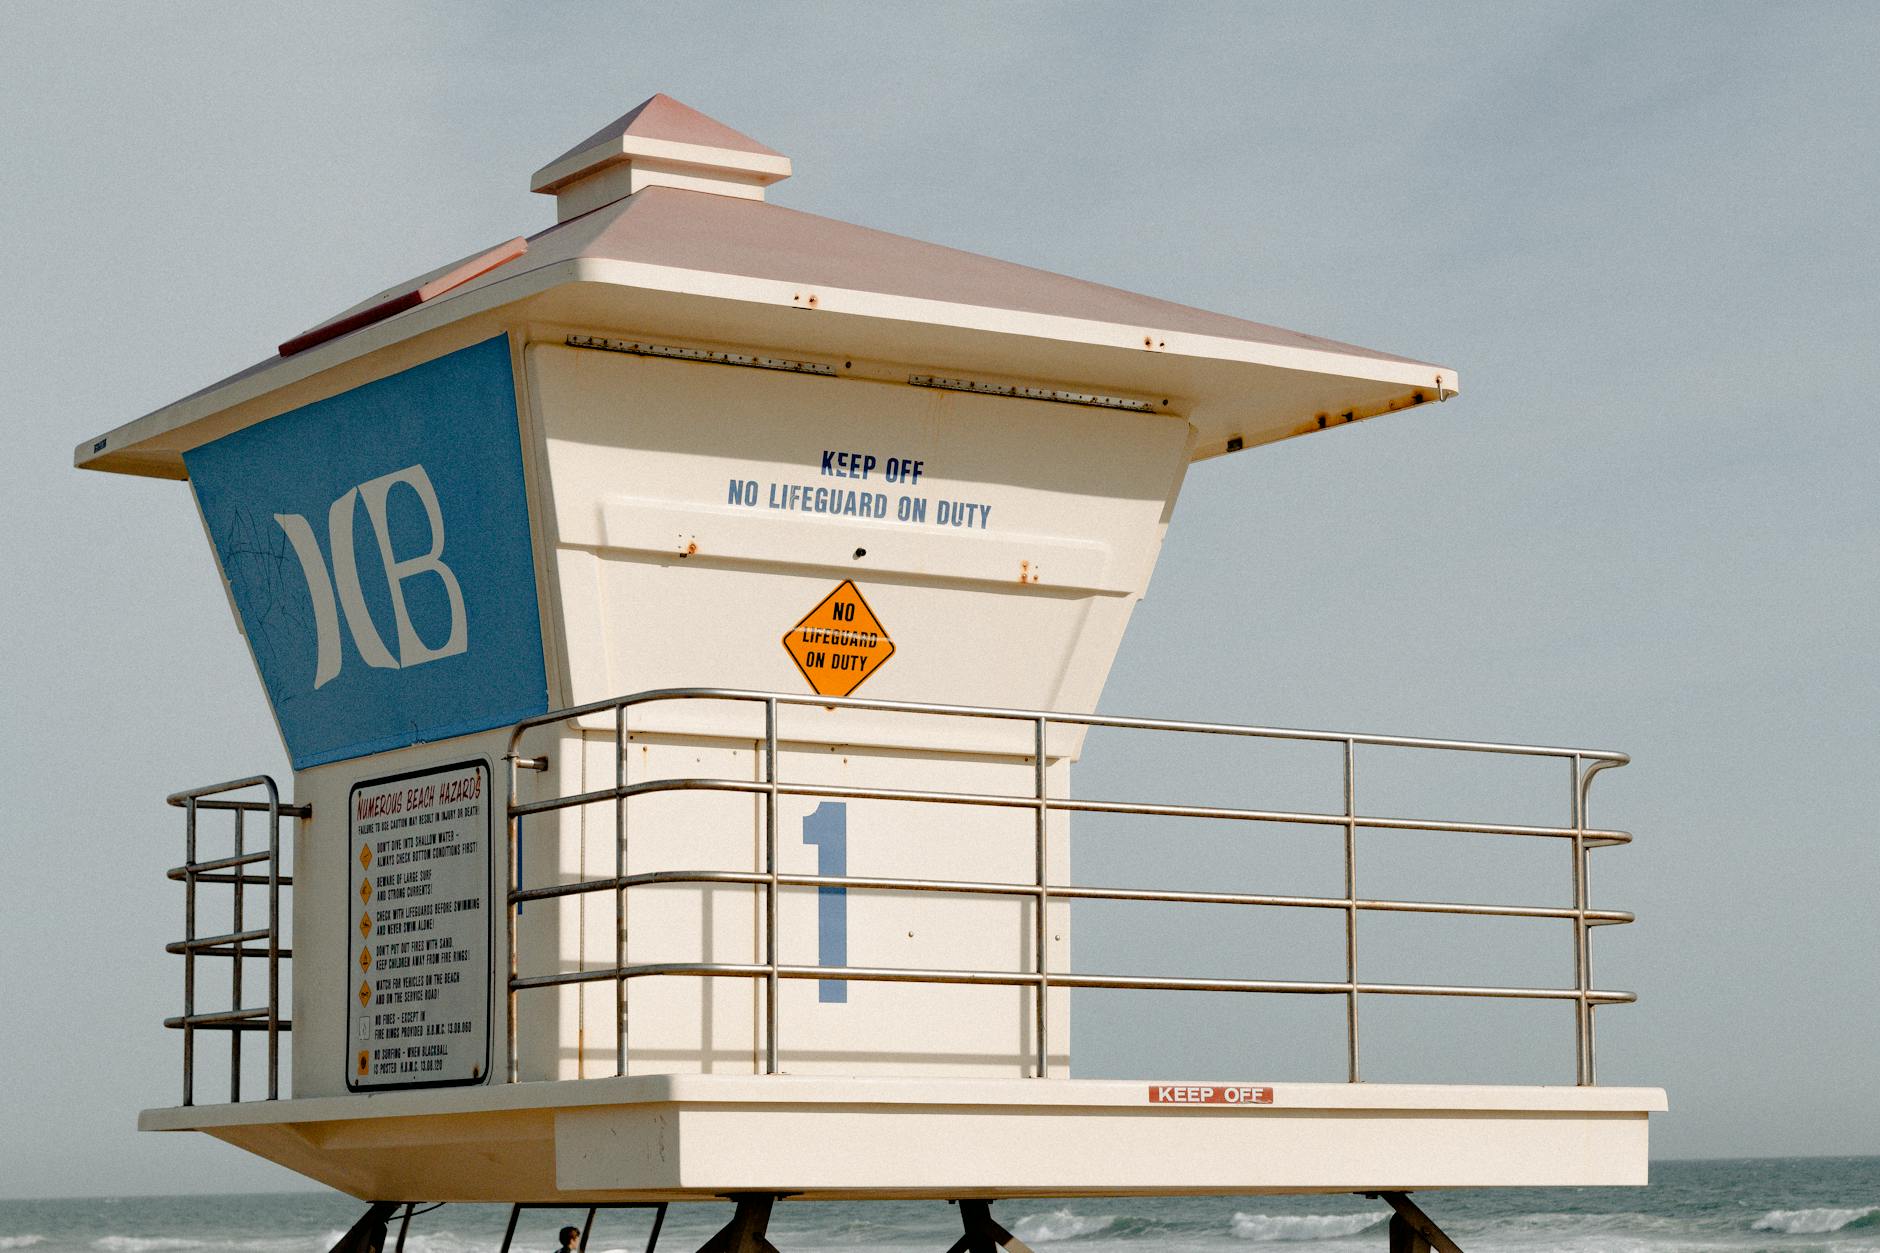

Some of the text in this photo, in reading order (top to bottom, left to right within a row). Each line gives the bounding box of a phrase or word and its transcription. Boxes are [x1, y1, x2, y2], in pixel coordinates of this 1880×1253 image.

[821, 450, 925, 486] KEEP OFF
[728, 479, 992, 531] NO LIFEGUARD ON DUTY
[833, 602, 855, 622] NO
[802, 626, 878, 648] LIFEGUARD
[806, 651, 868, 672] ON DUTY
[357, 776, 481, 821] NUMEROUS BEACH HAZARDS
[358, 823, 374, 835] FAILURE
[375, 822, 380, 832] TO
[381, 820, 389, 831] USE
[390, 817, 408, 830] CAUTION
[408, 815, 418, 827] MAY
[419, 813, 434, 825] RESULT
[434, 812, 440, 821] IN
[441, 808, 456, 821] INJURY
[457, 808, 463, 819] OR
[391, 839, 402, 851] DIVE
[402, 837, 414, 849] INTO
[415, 833, 437, 848] SHALLOW
[438, 830, 455, 843] WATER
[376, 855, 395, 868] ALWAYS
[396, 852, 411, 865] CHECK
[412, 848, 431, 862] BOTTOM
[432, 844, 460, 860] CONDITIONS
[376, 868, 432, 888] BEWARE OF LARGE SURF
[376, 890, 386, 902] AND
[387, 887, 406, 900] STRONG
[802, 801, 848, 1004] 1
[376, 897, 480, 922] CHECK WITH LIFEGUARDS BEFORE SWIMMING
[376, 924, 386, 936] AND
[387, 922, 402, 935] NEVER
[403, 920, 416, 933] SWIM
[390, 943, 400, 955] PUT
[401, 942, 410, 954] OUT
[411, 940, 424, 952] FIRES
[426, 938, 438, 951] WITH
[375, 959, 388, 971] KEEP
[388, 956, 411, 970] CHILDREN
[412, 954, 425, 967] AWAY
[426, 952, 440, 965] FROM
[441, 951, 452, 963] FIRE
[375, 971, 460, 991] WATCH FOR VEHICLES ON THE BEACH
[375, 993, 385, 1005] AND
[386, 992, 392, 1004] ON
[394, 991, 403, 1003] THE
[404, 989, 423, 1002] SERVICE
[375, 1014, 381, 1026] NO
[382, 1013, 396, 1025] FIRES
[401, 1010, 419, 1024] EXCEPT
[420, 1010, 425, 1021] IN
[374, 1028, 385, 1040] FIRE
[386, 1027, 400, 1039] RINGS
[401, 1024, 424, 1038] PROVIDED
[374, 1049, 381, 1060] NO
[382, 1047, 401, 1060] SURFING
[407, 1046, 420, 1058] WHEN
[422, 1044, 448, 1057] BLACKBALL
[373, 1063, 379, 1075] IS
[380, 1062, 397, 1074] POSTED
[1158, 1087, 1264, 1103] KEEP OFF
